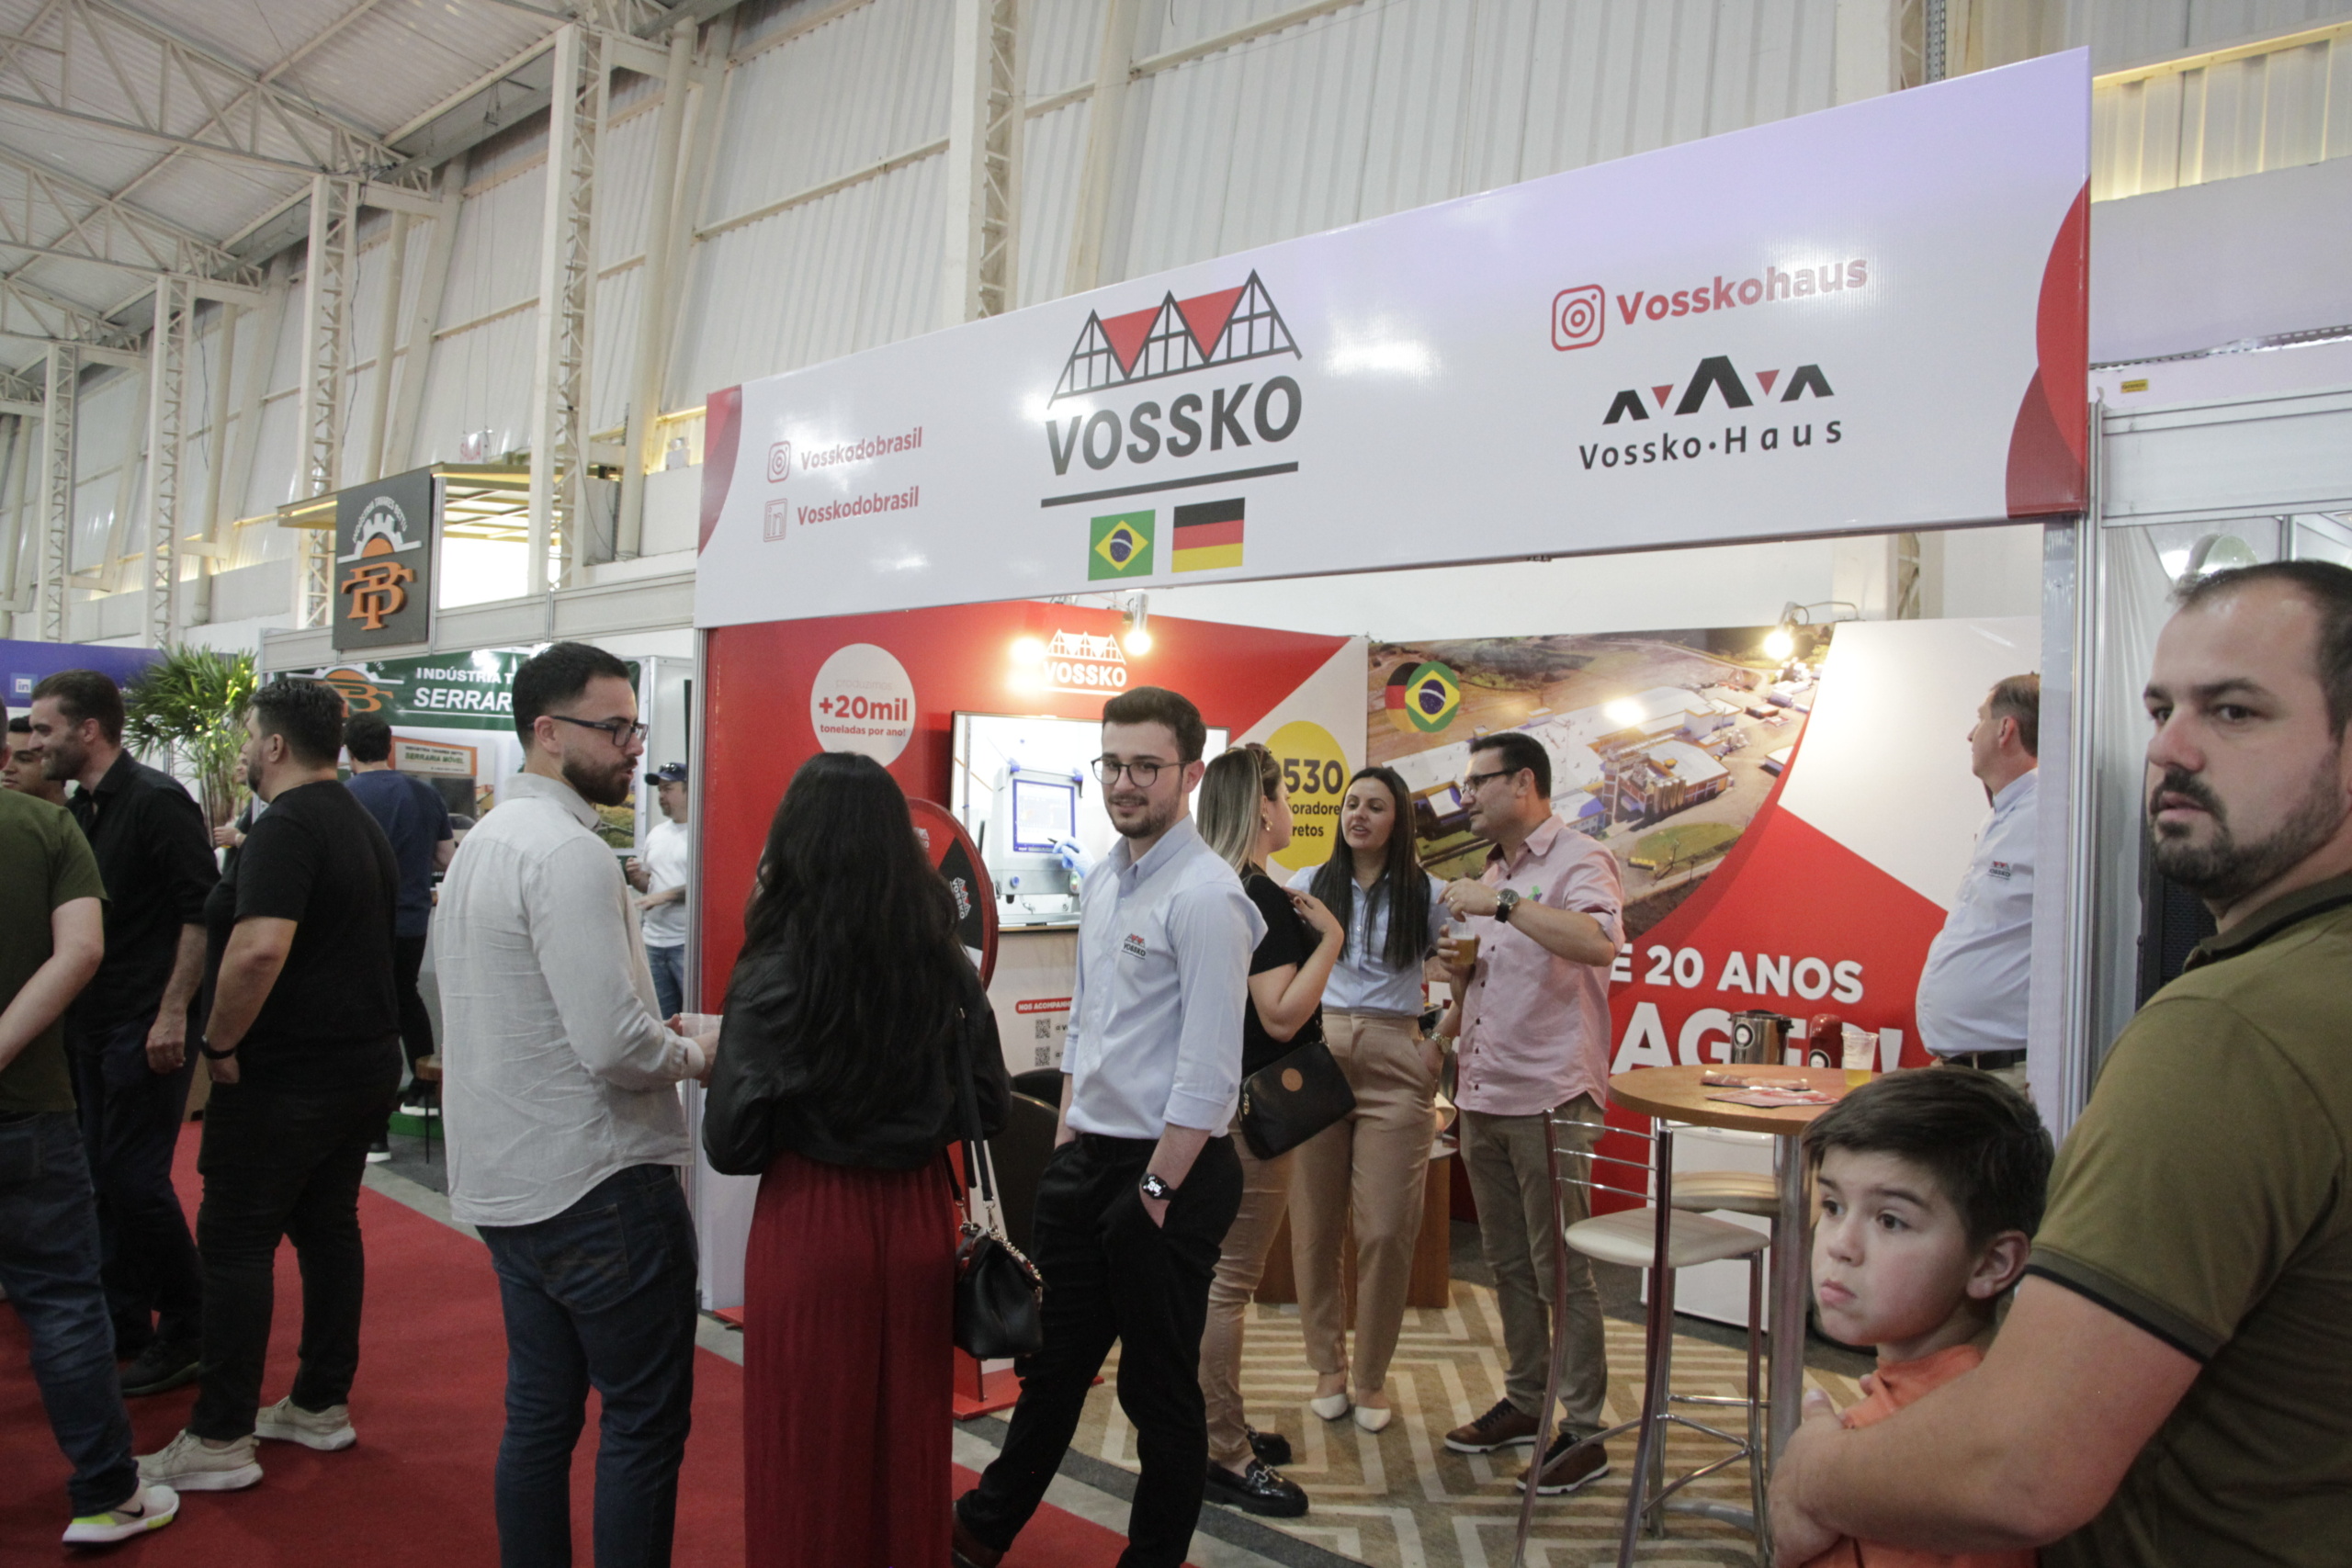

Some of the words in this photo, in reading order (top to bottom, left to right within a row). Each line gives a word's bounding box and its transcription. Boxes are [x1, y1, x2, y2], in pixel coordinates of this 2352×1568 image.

[1616, 259, 1868, 326] Vosskohaus
[1046, 375, 1303, 477] VOSSKO
[801, 426, 922, 470] Vosskodobrasil
[797, 485, 920, 525] Vosskodobrasil
[416, 666, 502, 684] INDÚSTRIA
[503, 672, 514, 684] T
[1043, 660, 1127, 688] VOSSKO
[413, 686, 513, 712] SERRAR
[819, 694, 908, 721] +20mil
[820, 724, 866, 735] toneladas
[868, 728, 884, 737] por
[886, 728, 906, 737] ano!
[1289, 801, 1340, 816] oradore
[1292, 824, 1324, 837] retos
[1610, 942, 1634, 983] E
[1645, 944, 1704, 988] 20
[1716, 951, 1864, 1004] ANOS
[1034, 1000, 1071, 1010] ACOMPANH
